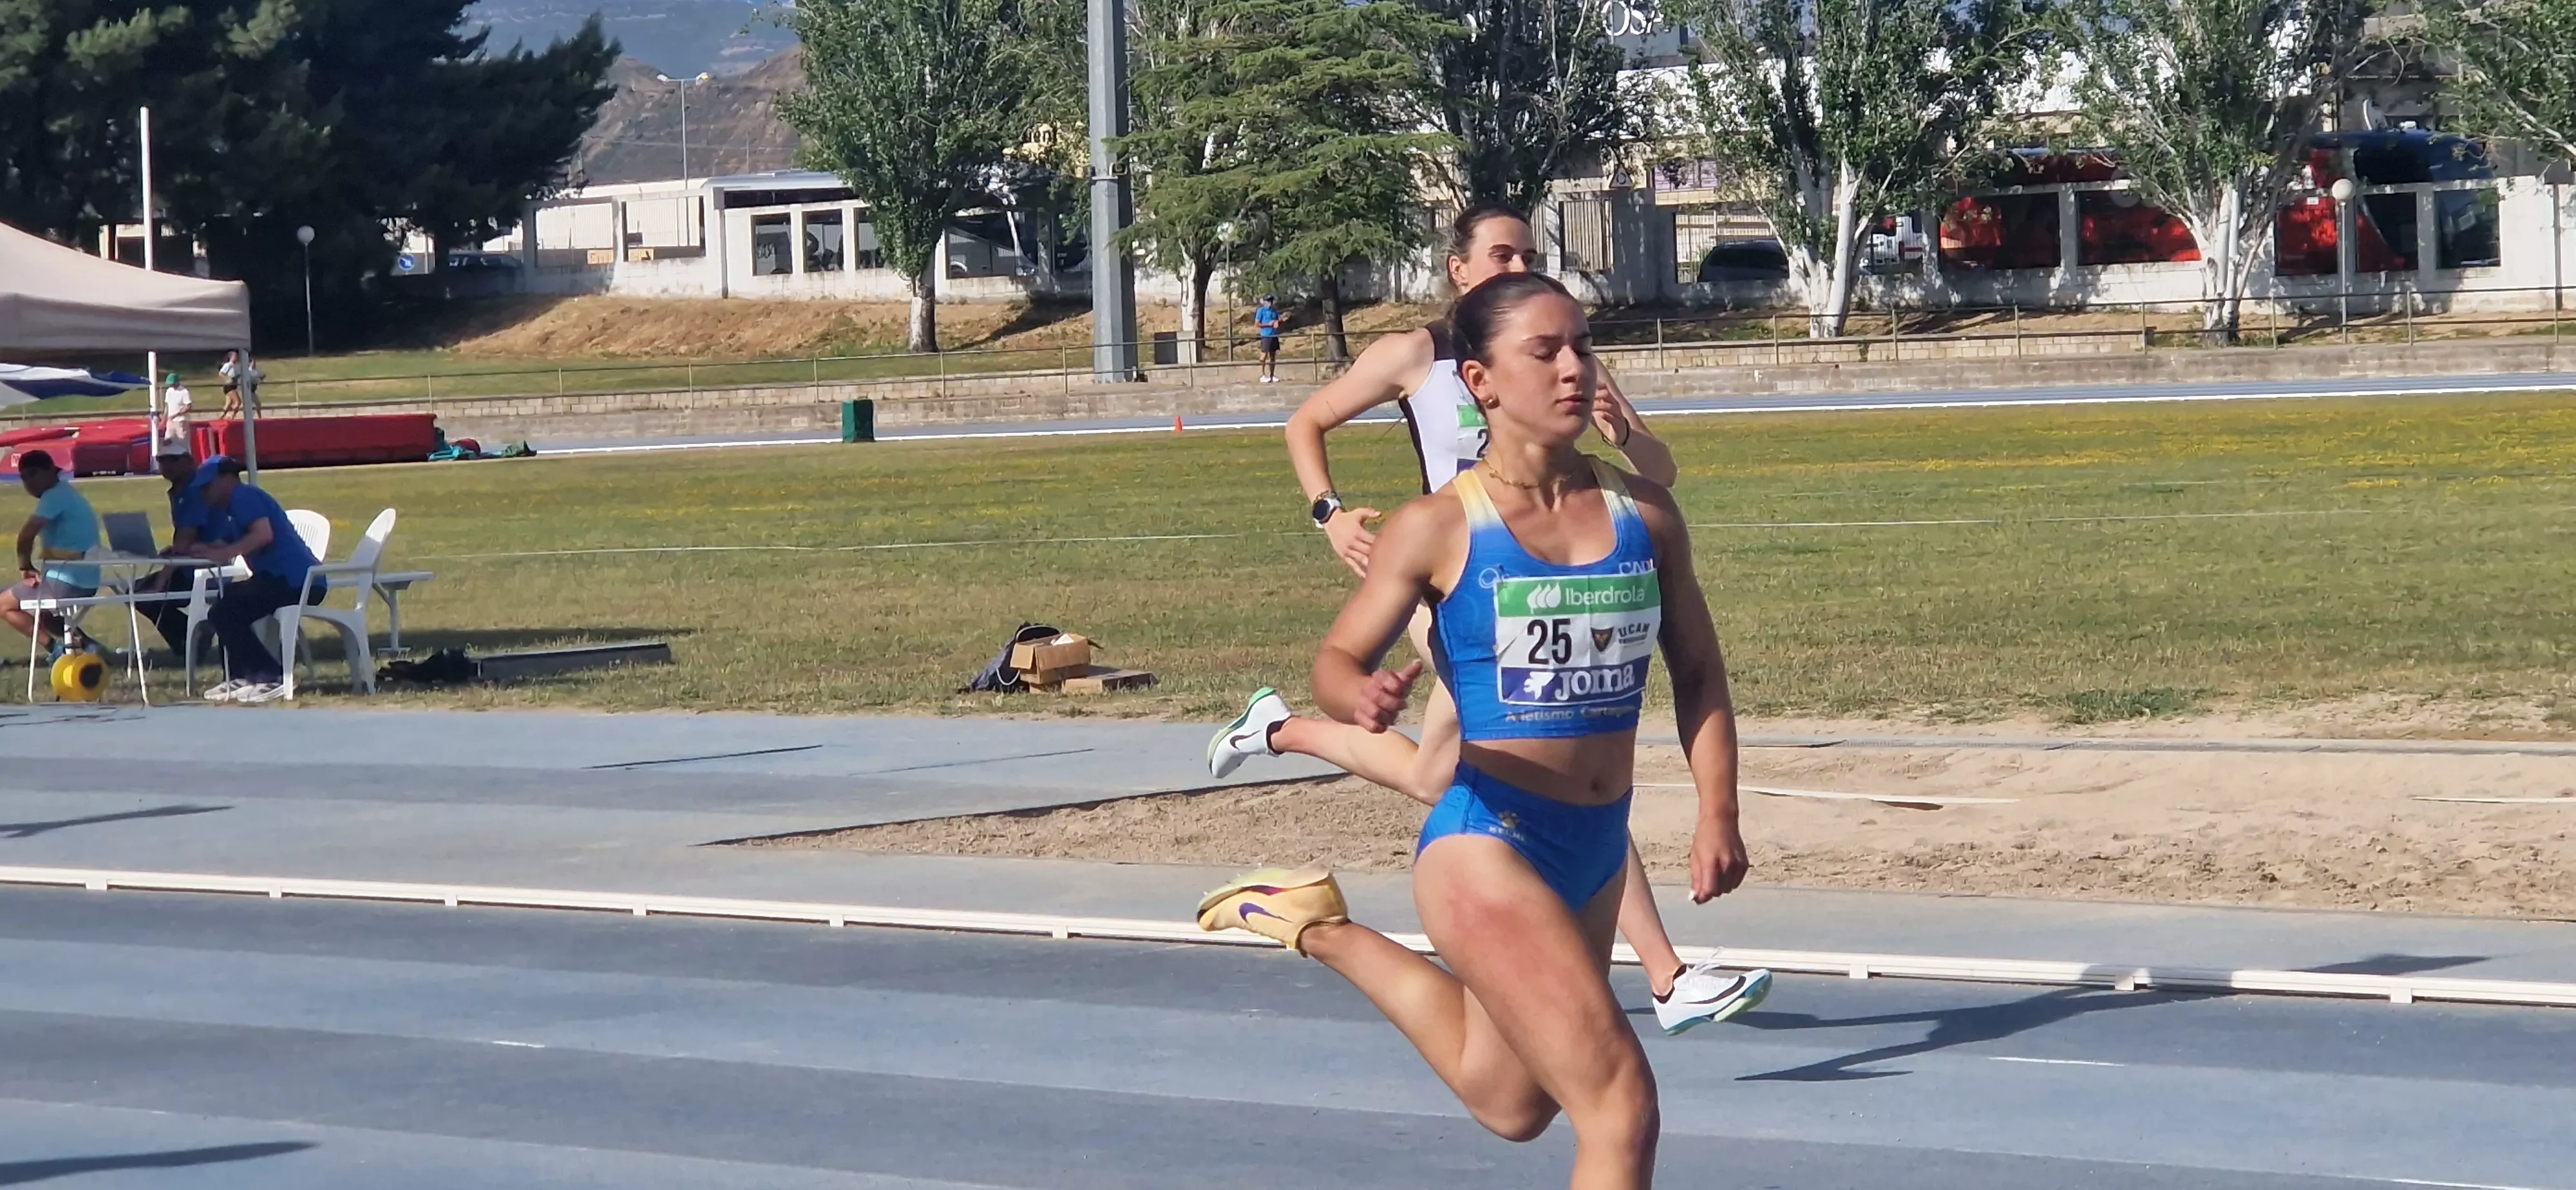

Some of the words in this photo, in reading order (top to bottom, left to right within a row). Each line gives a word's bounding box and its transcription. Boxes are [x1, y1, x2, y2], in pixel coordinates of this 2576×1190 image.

[1566, 585, 1645, 605] Iberdrola
[1618, 623, 1651, 638] UCAM
[1527, 618, 1573, 665] 25
